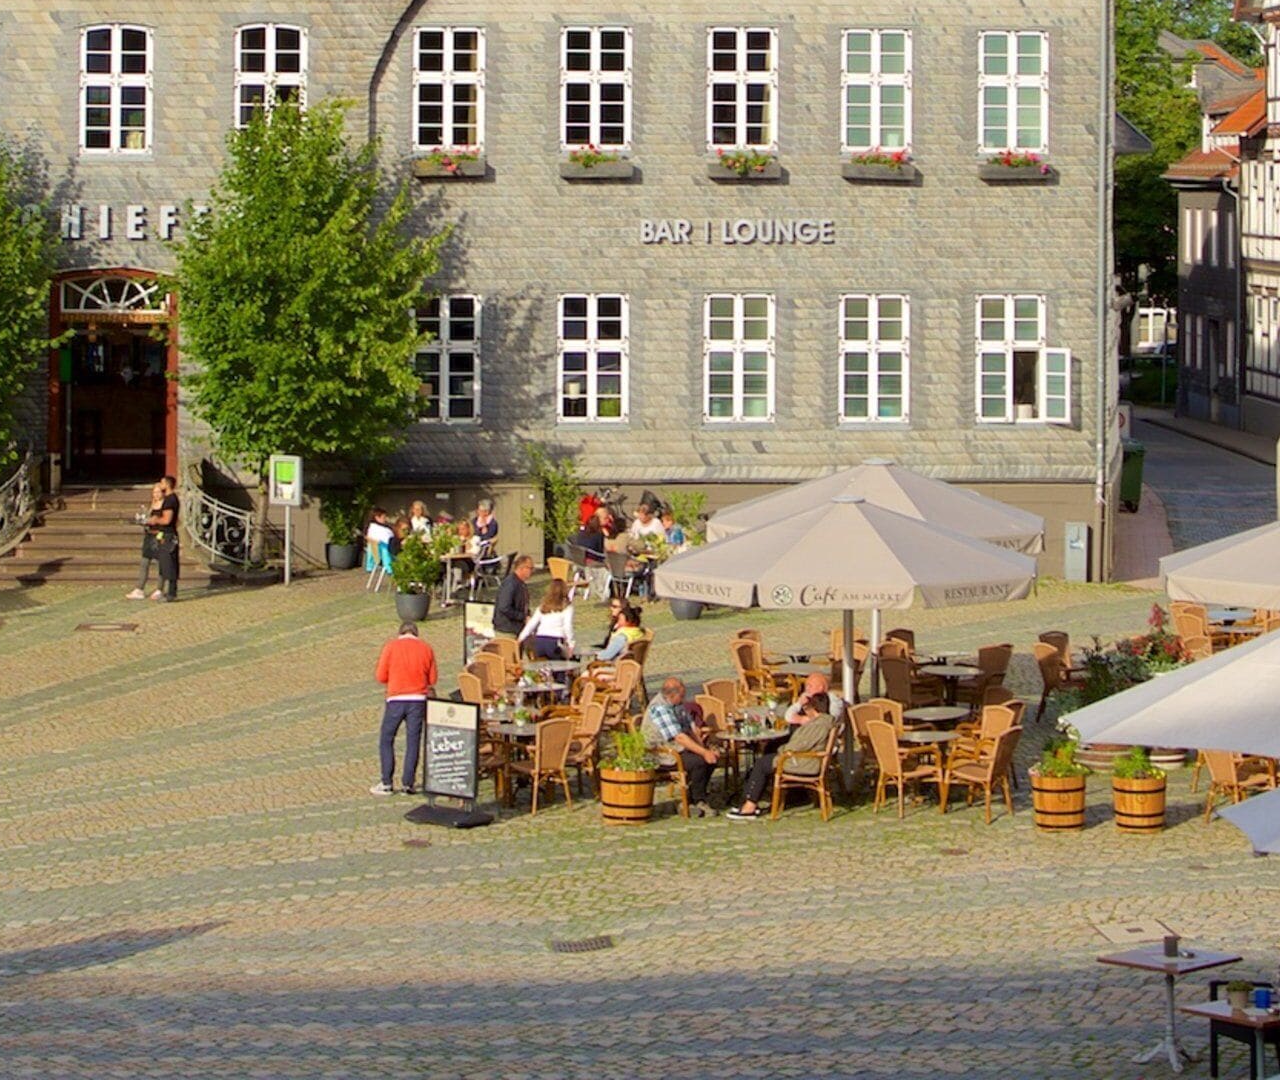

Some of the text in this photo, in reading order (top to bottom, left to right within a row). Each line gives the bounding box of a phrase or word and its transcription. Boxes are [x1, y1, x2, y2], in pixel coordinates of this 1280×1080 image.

[639, 220, 693, 244] BAR
[722, 219, 836, 245] LOUNGE
[674, 579, 732, 599] RESTAURANT
[799, 583, 903, 607] Café AM MARKT
[943, 583, 1011, 601] RESTAURANT
